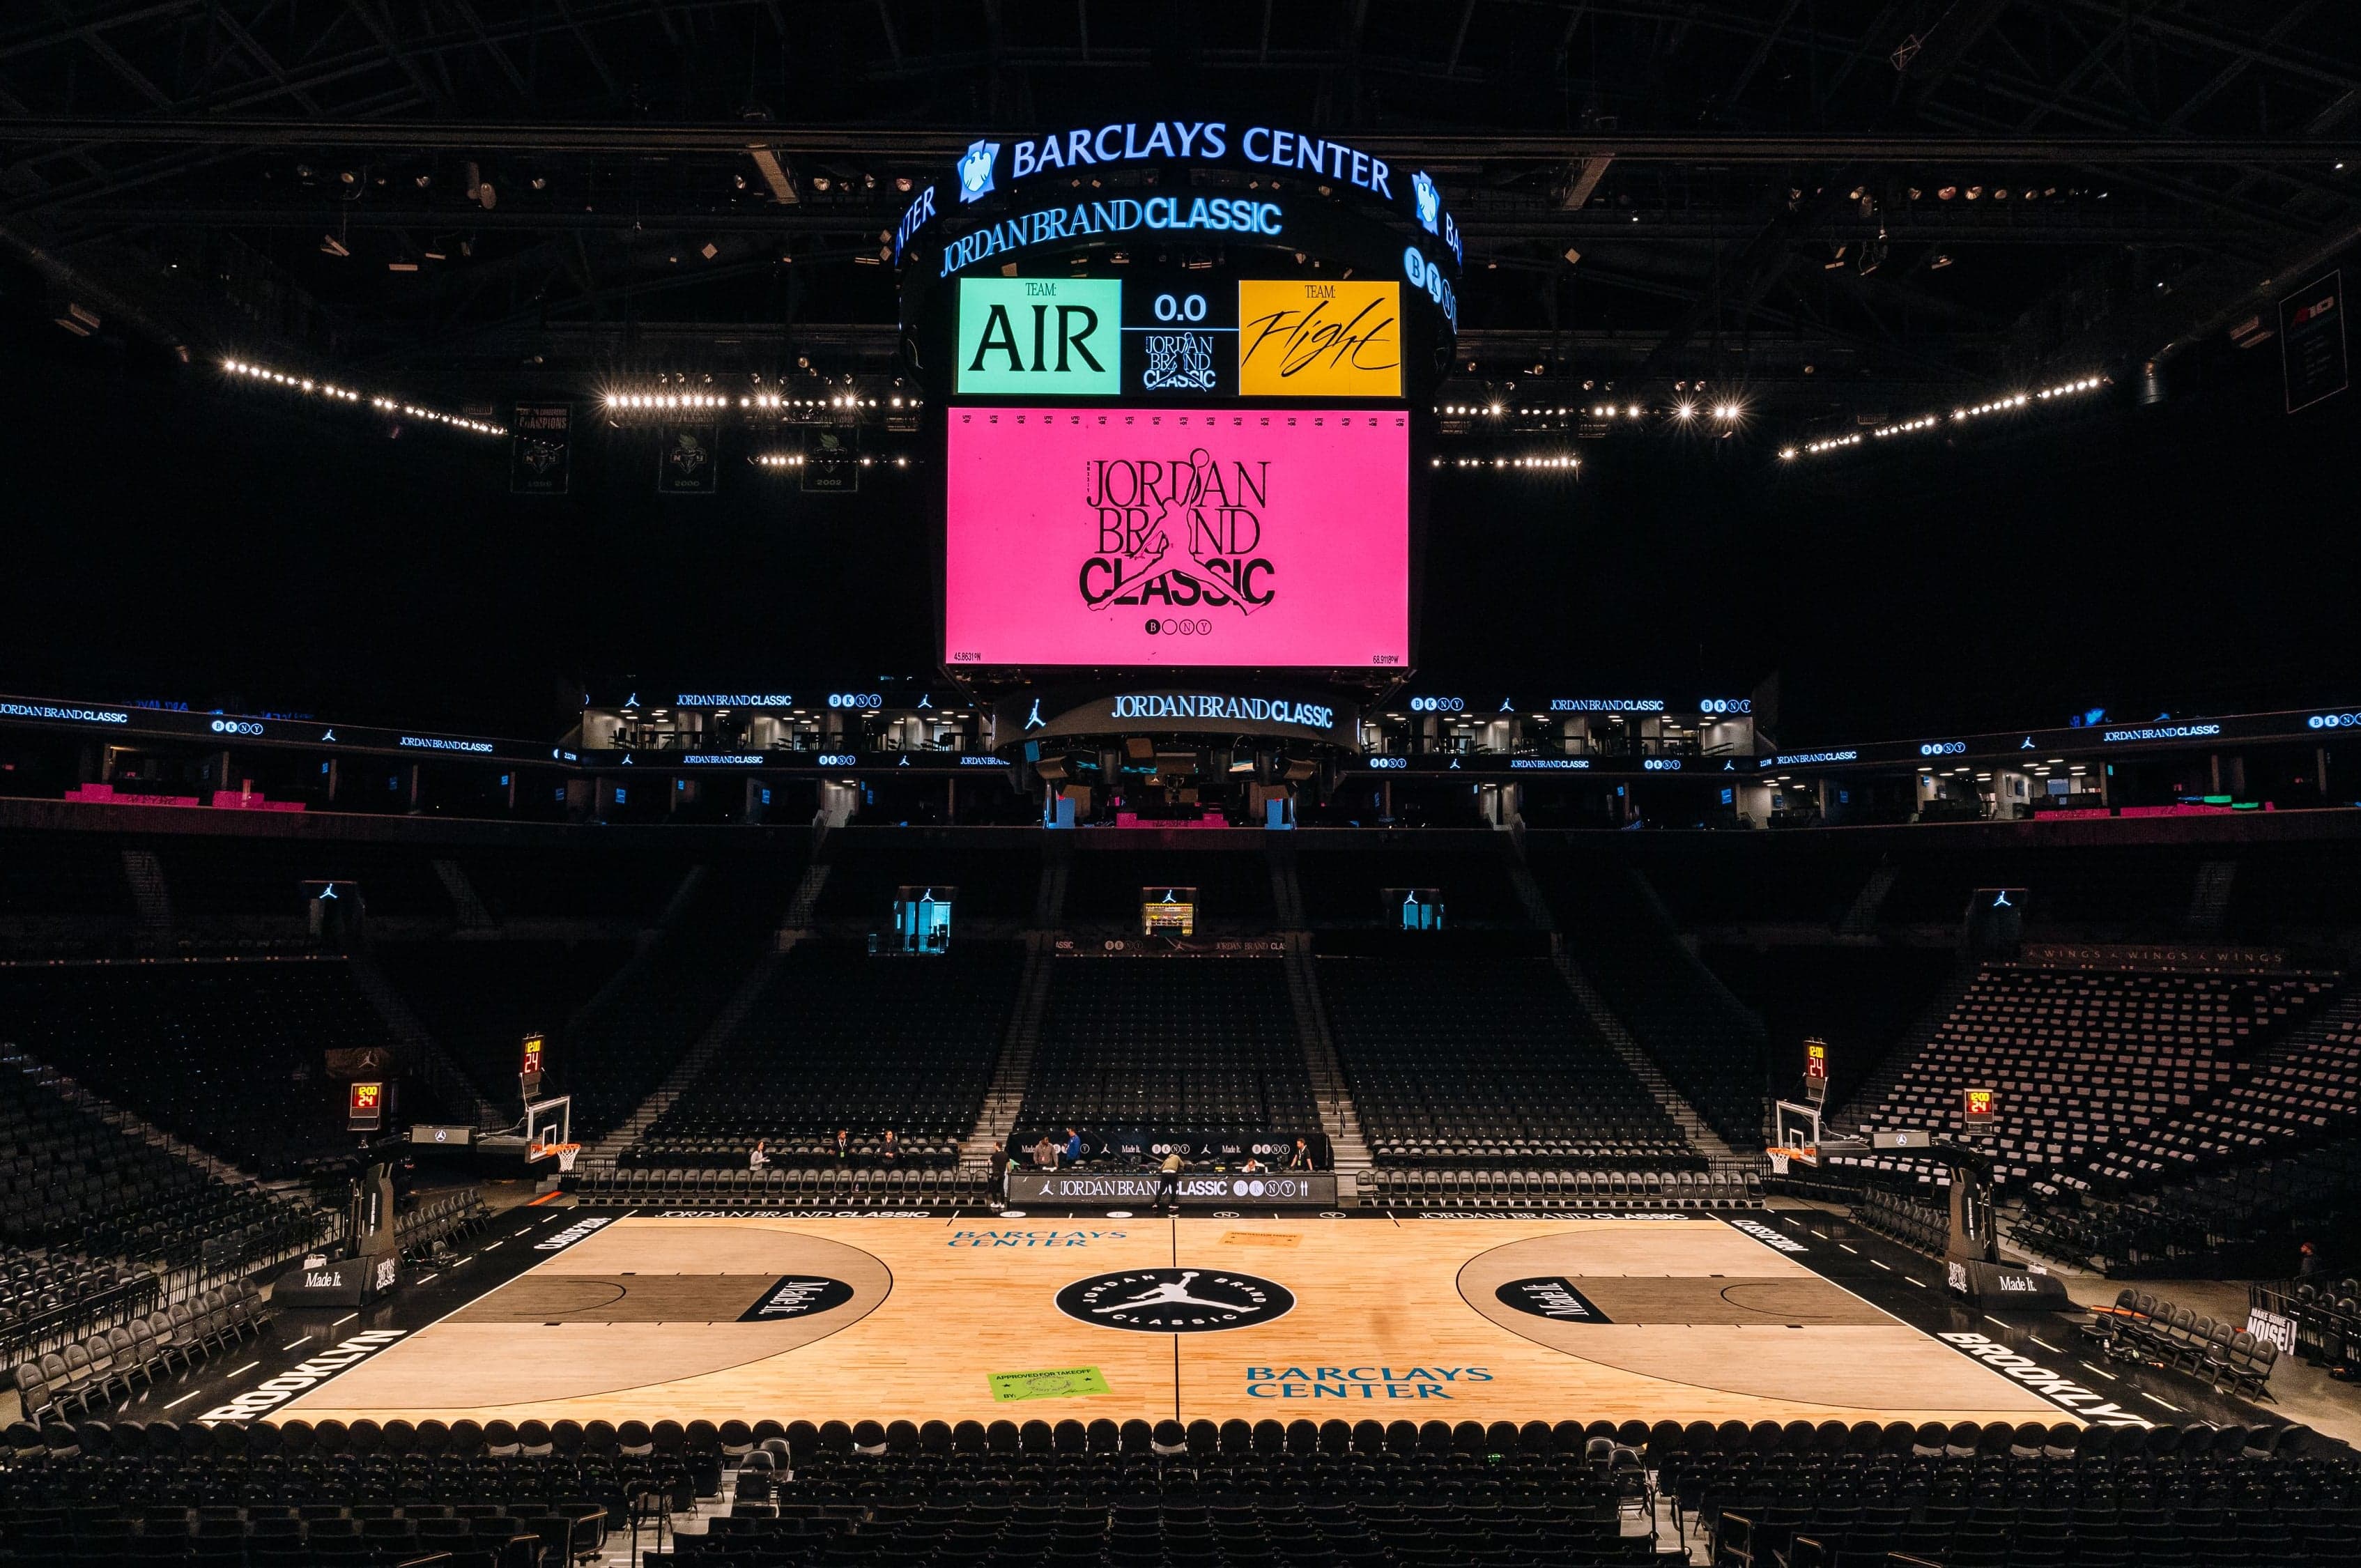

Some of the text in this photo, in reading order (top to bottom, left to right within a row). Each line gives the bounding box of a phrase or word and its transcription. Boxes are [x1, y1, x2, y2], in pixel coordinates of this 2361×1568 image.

[1012, 121, 1394, 201] BARCLAYS CENTER
[939, 197, 1283, 278] JORDAN BRAND CLASSIC
[1025, 282, 1057, 298] TEAM:
[1305, 284, 1336, 299] TEAM:
[1154, 293, 1206, 323] 0.0
[967, 303, 1106, 373] AIR
[1146, 336, 1215, 354] JORDAN
[1240, 297, 1400, 378] Flight
[1086, 460, 1271, 508] JORDAN
[1079, 557, 1275, 607] CLASSIC
[677, 694, 792, 706] JORDAN BRAND CLASSIC
[1550, 699, 1664, 711] JORDAN BRAND CLASSIC
[1112, 695, 1334, 729] JORDAN BRAND CLASSIC
[2104, 724, 2220, 741] JORDAN BRAND CLASSIC
[2044, 949, 2283, 962] WINGS WINGS WINGS
[524, 1054, 539, 1073] 24
[1809, 1057, 1823, 1077] 24
[358, 1096, 374, 1107] 24
[1971, 1101, 1986, 1112] 24
[1122, 1145, 1136, 1153] Made
[1222, 1144, 1236, 1153] Made
[1059, 1180, 1115, 1196] JORDAN
[654, 1210, 932, 1219] JORDAN BRAND CLASSIC
[1418, 1211, 1690, 1221] JORDAN BRAND CLASSIC
[947, 1239, 1089, 1247] CENTER
[954, 1231, 1128, 1239] BARCLAYS
[305, 1272, 341, 1288] Made It.
[1999, 1275, 2038, 1293] Made It.
[770, 1281, 830, 1305] Made
[1083, 1274, 1155, 1303] JORDAN
[1213, 1277, 1266, 1303] BRAND
[1529, 1291, 1590, 1316] Made
[1112, 1314, 1238, 1325] CLASSIC
[2251, 1307, 2286, 1327] MAKE SOME
[1247, 1367, 1494, 1382] BARCLAYS
[1247, 1383, 1455, 1399] CENTER
